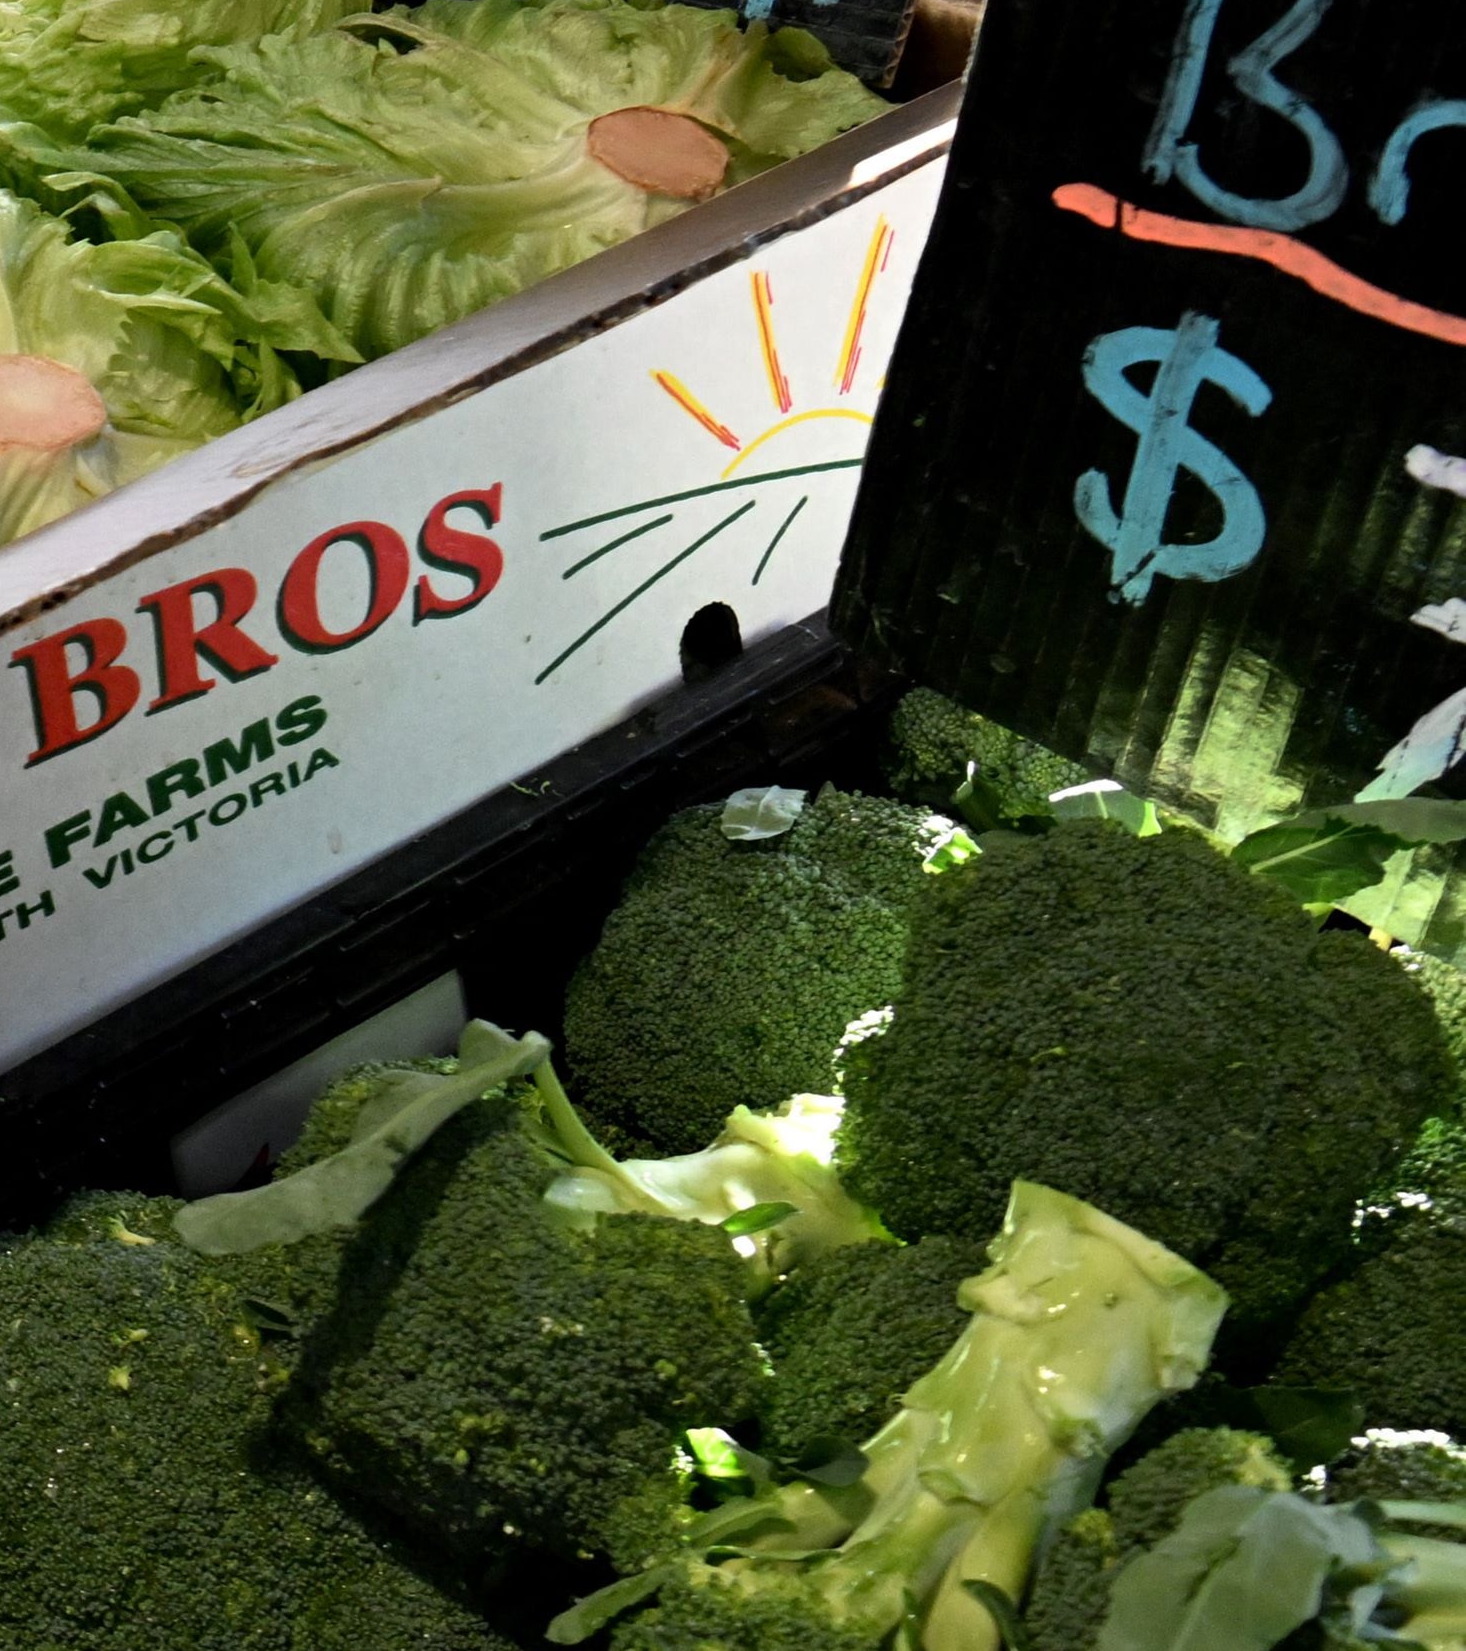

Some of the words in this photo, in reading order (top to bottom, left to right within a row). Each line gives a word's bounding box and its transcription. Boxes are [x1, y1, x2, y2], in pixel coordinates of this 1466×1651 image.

[9, 481, 505, 769] BROS
[45, 694, 330, 870] FARMS
[81, 747, 341, 890] VICTORIA
